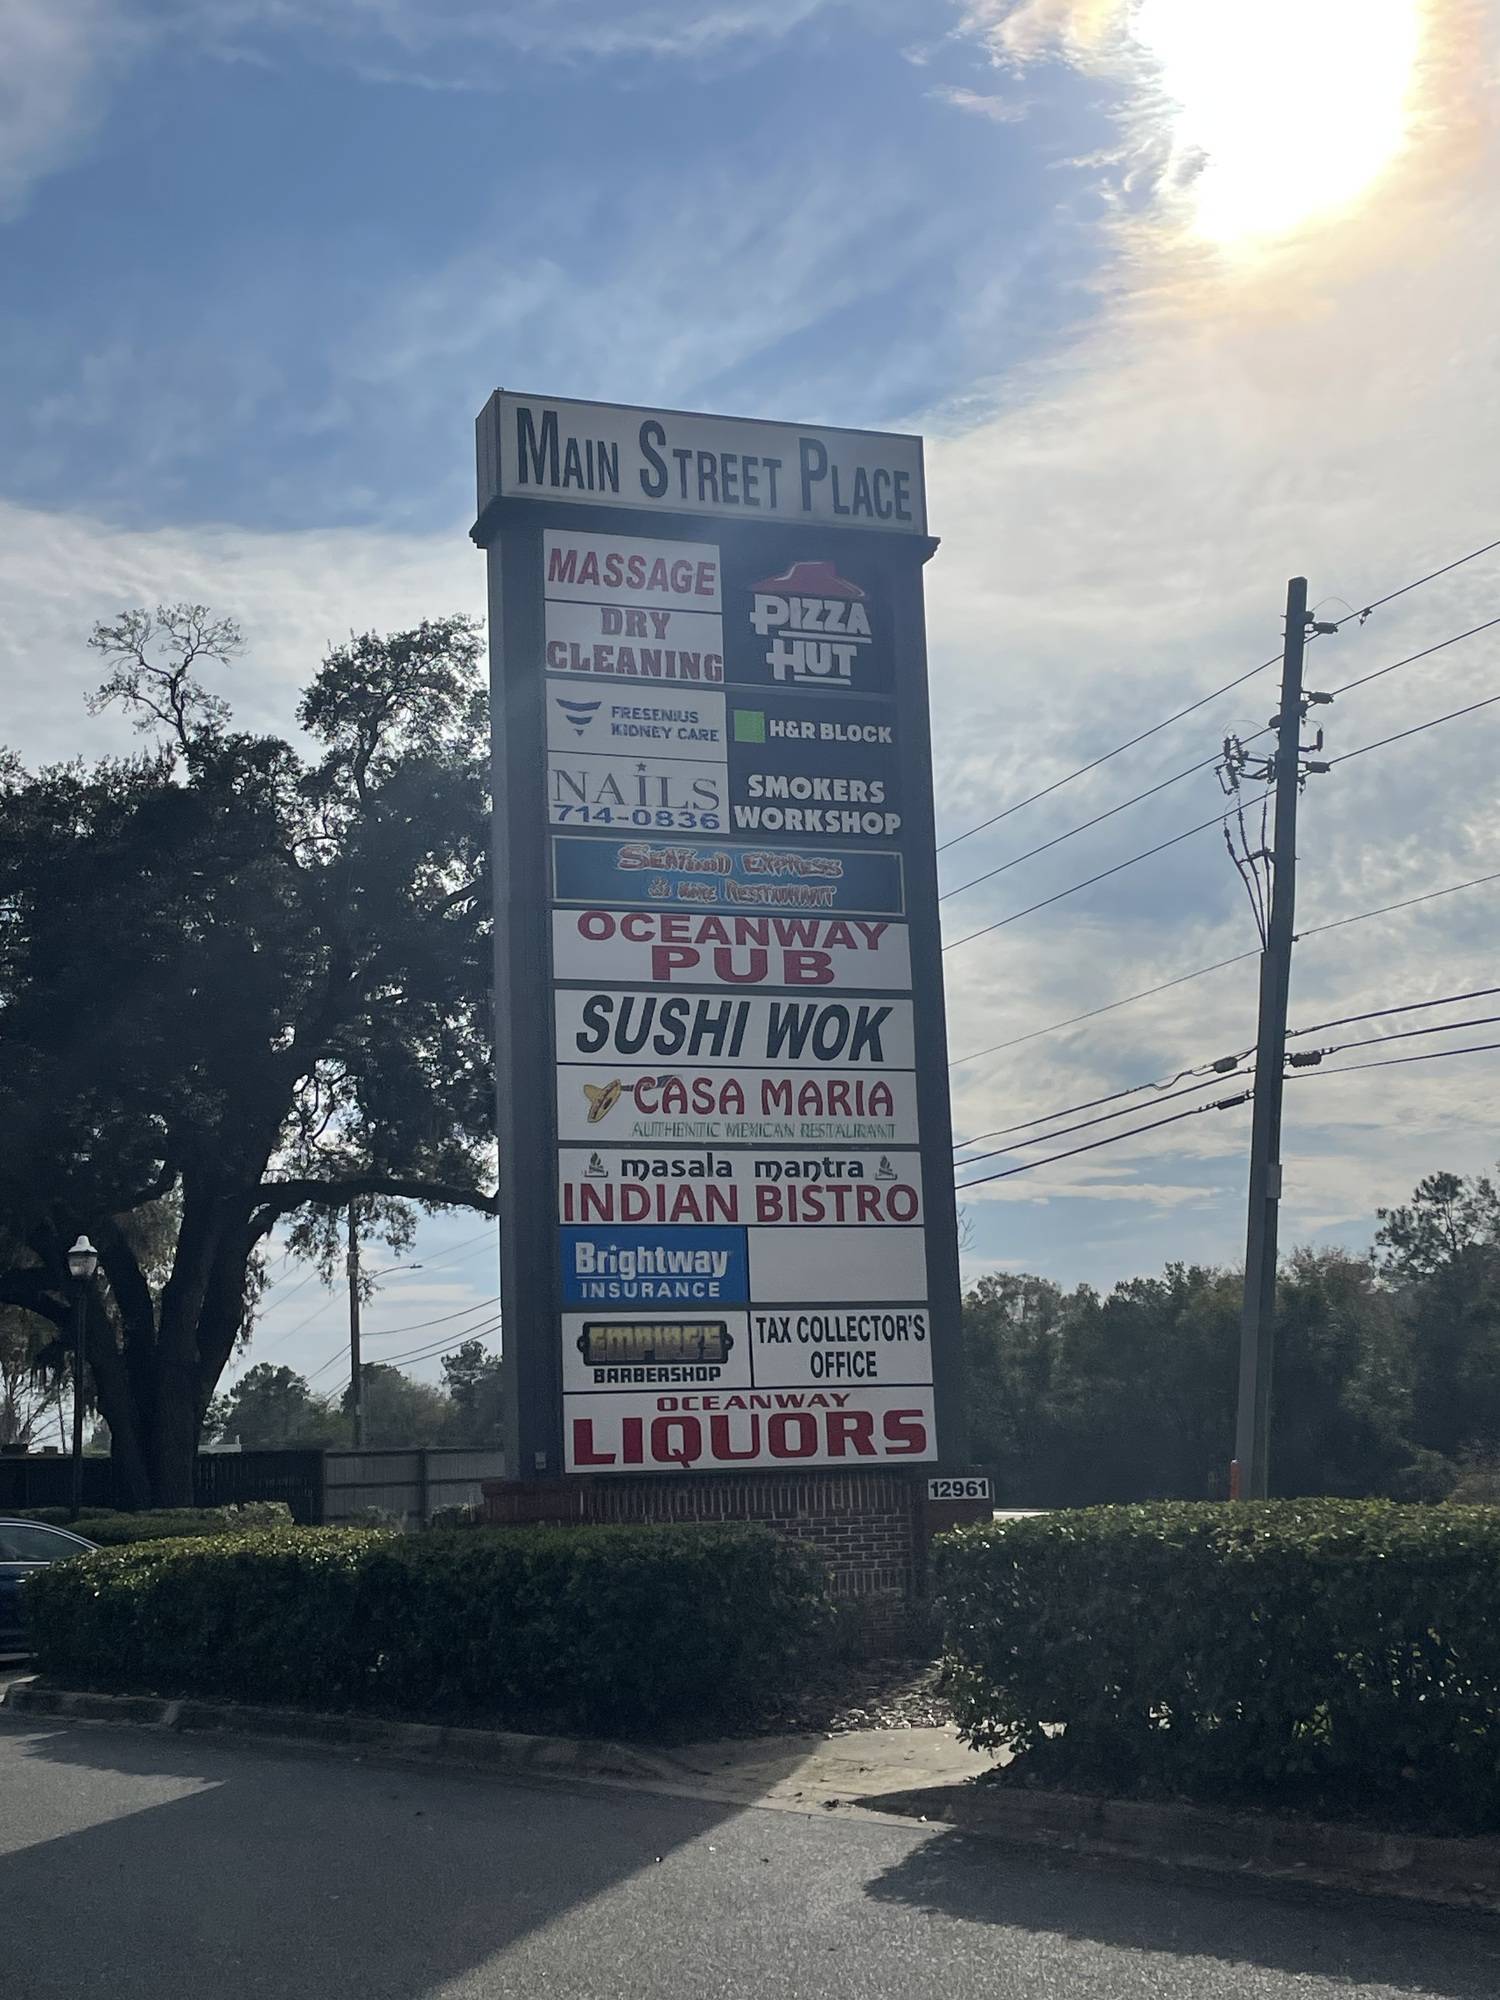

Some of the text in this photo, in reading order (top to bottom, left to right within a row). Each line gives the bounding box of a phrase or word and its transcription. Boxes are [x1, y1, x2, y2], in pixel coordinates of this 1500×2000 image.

[517, 408, 913, 521] MAIN STREET PLACE
[548, 548, 717, 596] MASSAGE
[600, 607, 671, 641] DRY
[749, 593, 872, 636] PIZZA
[545, 640, 722, 683] CLEANING
[766, 638, 858, 681] HUT
[611, 706, 699, 724] FRESENIUS
[611, 723, 720, 742] KIDNEY CARE
[769, 719, 893, 744] H&R BLOCK
[748, 774, 885, 804] SMOKERS
[553, 804, 721, 830] 714-0836
[733, 805, 901, 836] WORKSHOP
[577, 911, 889, 951] OCEANWAY
[651, 944, 836, 986] PUB
[576, 994, 894, 1062] SUSHI WOK
[633, 1076, 895, 1117] CASA MARIA
[632, 1121, 896, 1139] AUTHENTIC MEXICAN RESTAURANT
[621, 1152, 864, 1182] masala mantra
[563, 1182, 920, 1223] INDIAN BISTRO
[575, 1242, 728, 1281] Brightway
[581, 1281, 721, 1299] INSURANCE
[755, 1314, 926, 1344] TAX COLLECTOR'S
[594, 1366, 721, 1384] BARBERSHOP
[810, 1350, 878, 1378] OFFICE
[656, 1392, 851, 1412] OCEANWAY
[573, 1408, 927, 1468] LIQUORS
[929, 1479, 989, 1499] 12961
